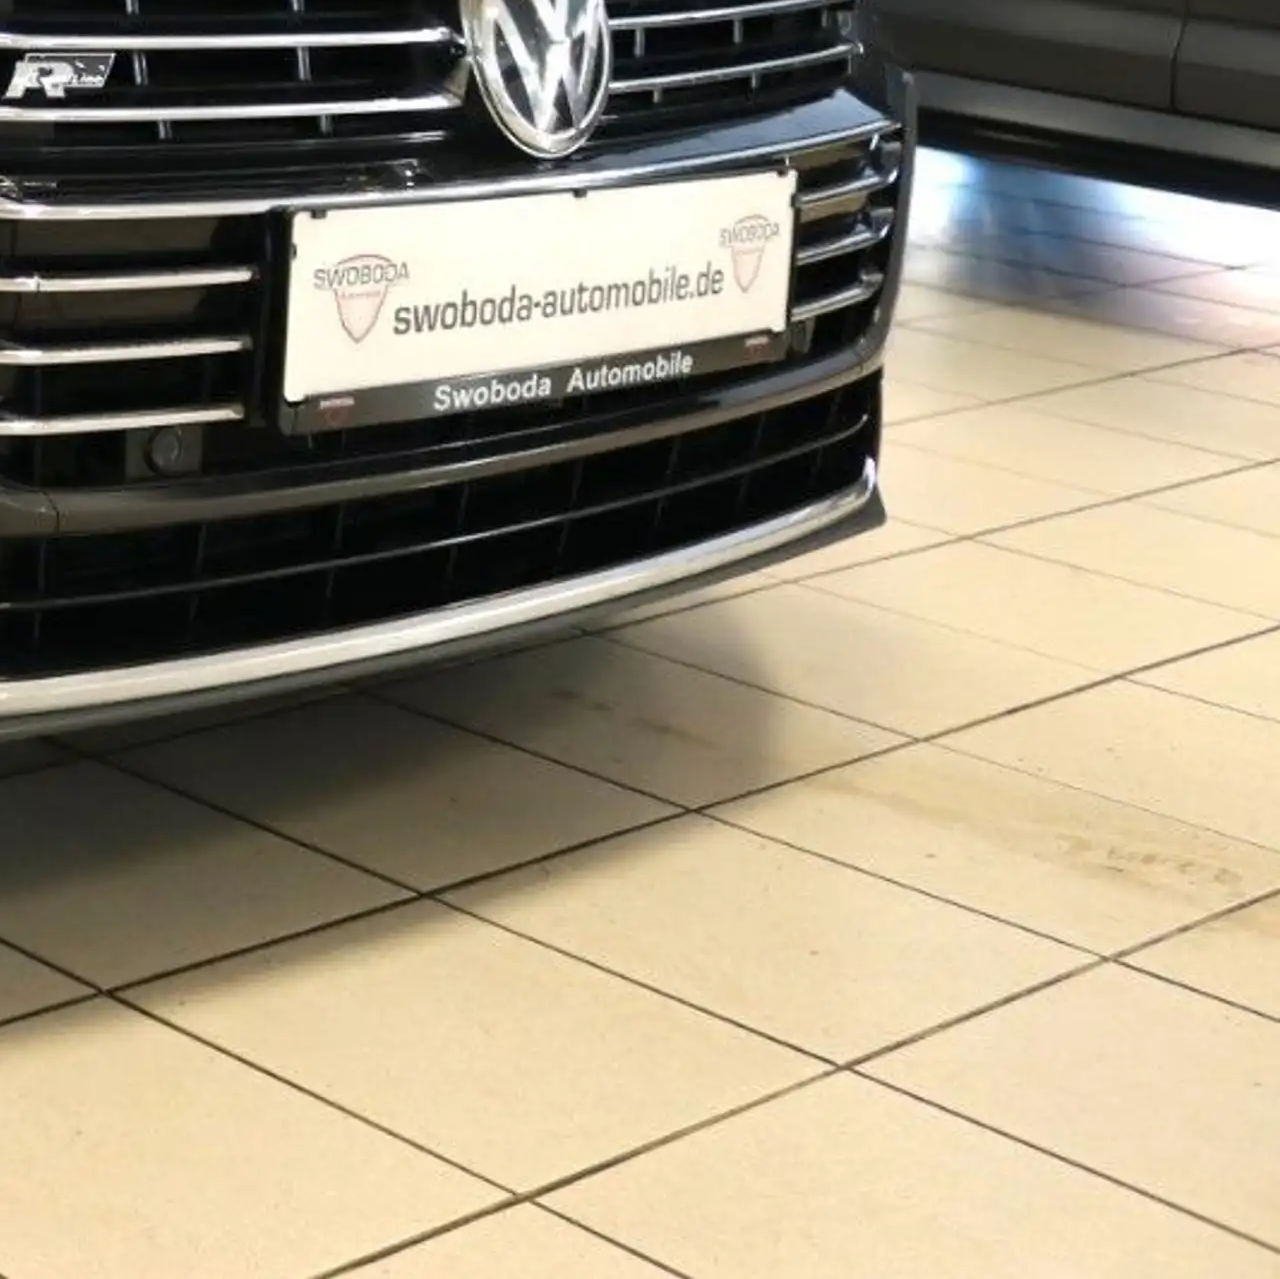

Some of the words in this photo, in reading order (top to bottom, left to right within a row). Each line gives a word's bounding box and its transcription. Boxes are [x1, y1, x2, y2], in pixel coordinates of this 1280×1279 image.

[313, 261, 410, 291] SWOBODA
[393, 260, 724, 336] swoboda-automobile.de
[434, 374, 552, 412] Swoboda
[565, 351, 693, 394] Automobile
